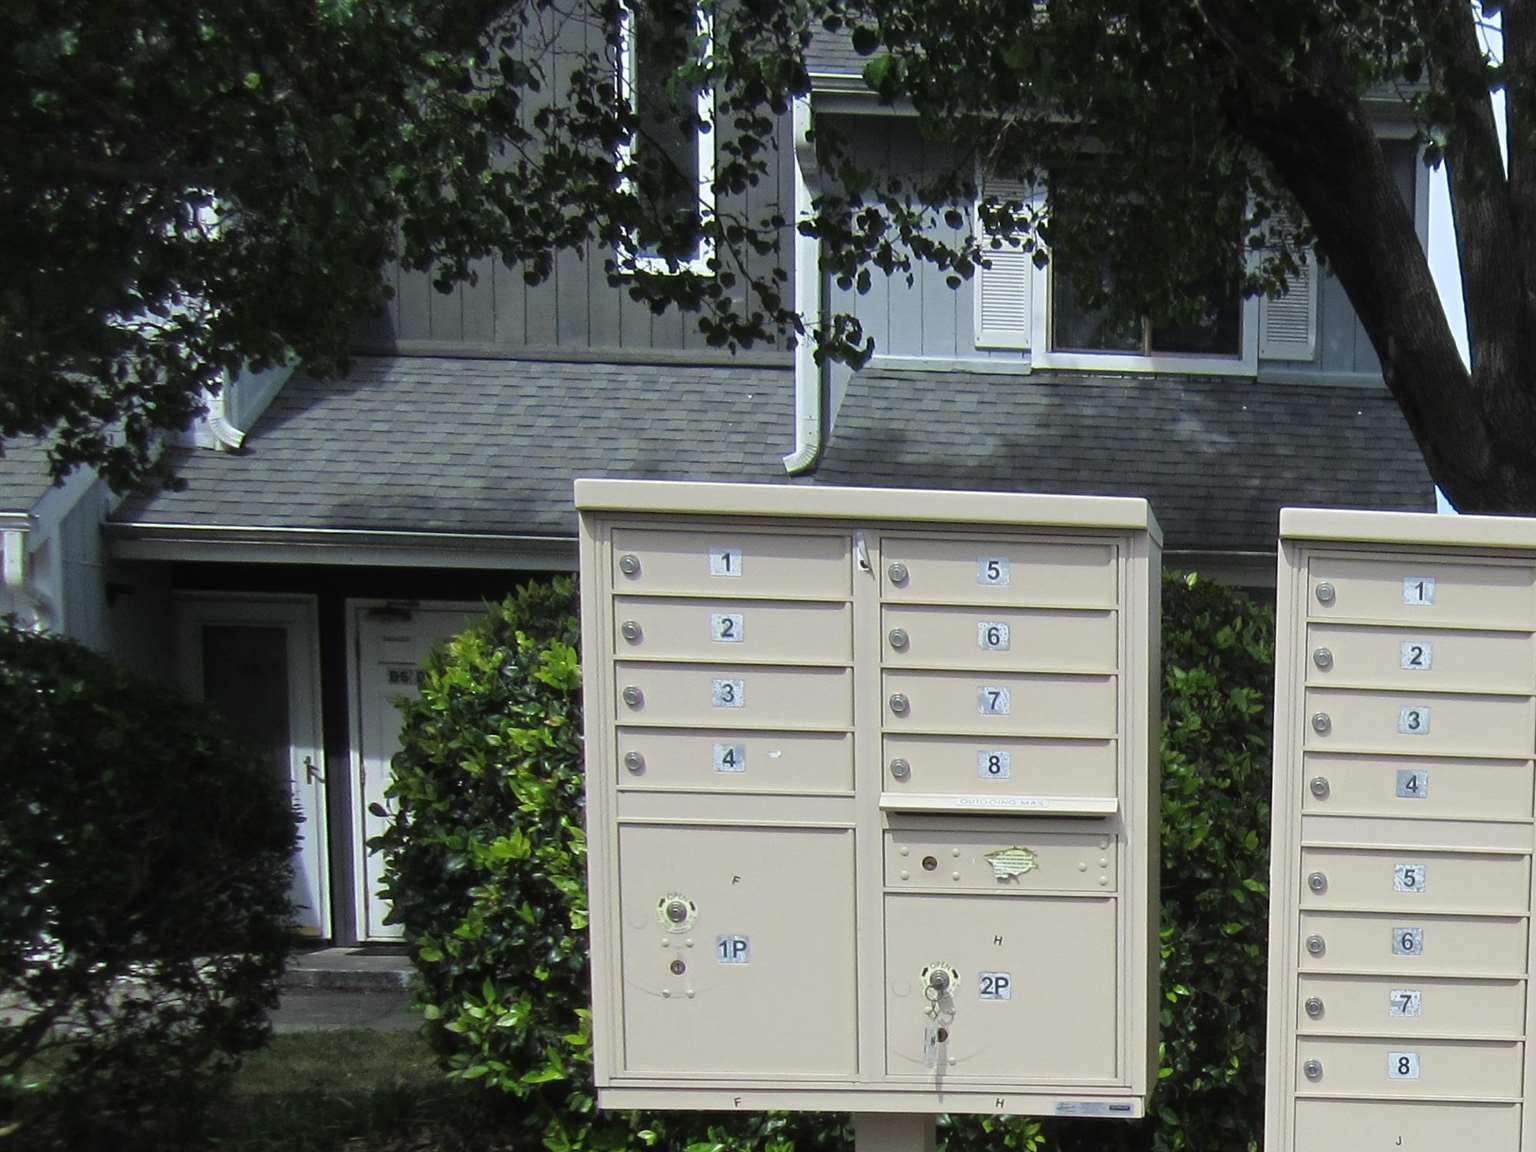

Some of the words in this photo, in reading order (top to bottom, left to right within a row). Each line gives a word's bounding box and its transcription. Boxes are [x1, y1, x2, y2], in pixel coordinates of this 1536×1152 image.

[720, 551, 732, 573] 1
[986, 559, 1001, 581] 5
[1414, 580, 1425, 602] 1
[719, 616, 736, 639] 2
[986, 625, 1001, 647] 6
[1408, 645, 1424, 667] 2
[719, 682, 736, 704] 3
[986, 690, 1002, 712] 7
[1407, 709, 1422, 731] 3
[721, 747, 738, 769] 4
[987, 754, 1002, 776] 8
[1404, 774, 1420, 795] 4
[731, 875, 741, 885] F
[1402, 867, 1417, 889] 5
[719, 939, 748, 959] 1P
[993, 935, 1003, 946] H
[1400, 931, 1415, 952] 6
[980, 976, 1009, 997] 2P
[1398, 993, 1413, 1015] 7
[1396, 1055, 1411, 1076] 8
[734, 1096, 742, 1108] F
[995, 1097, 1005, 1109] H
[1395, 1135, 1402, 1146] J
